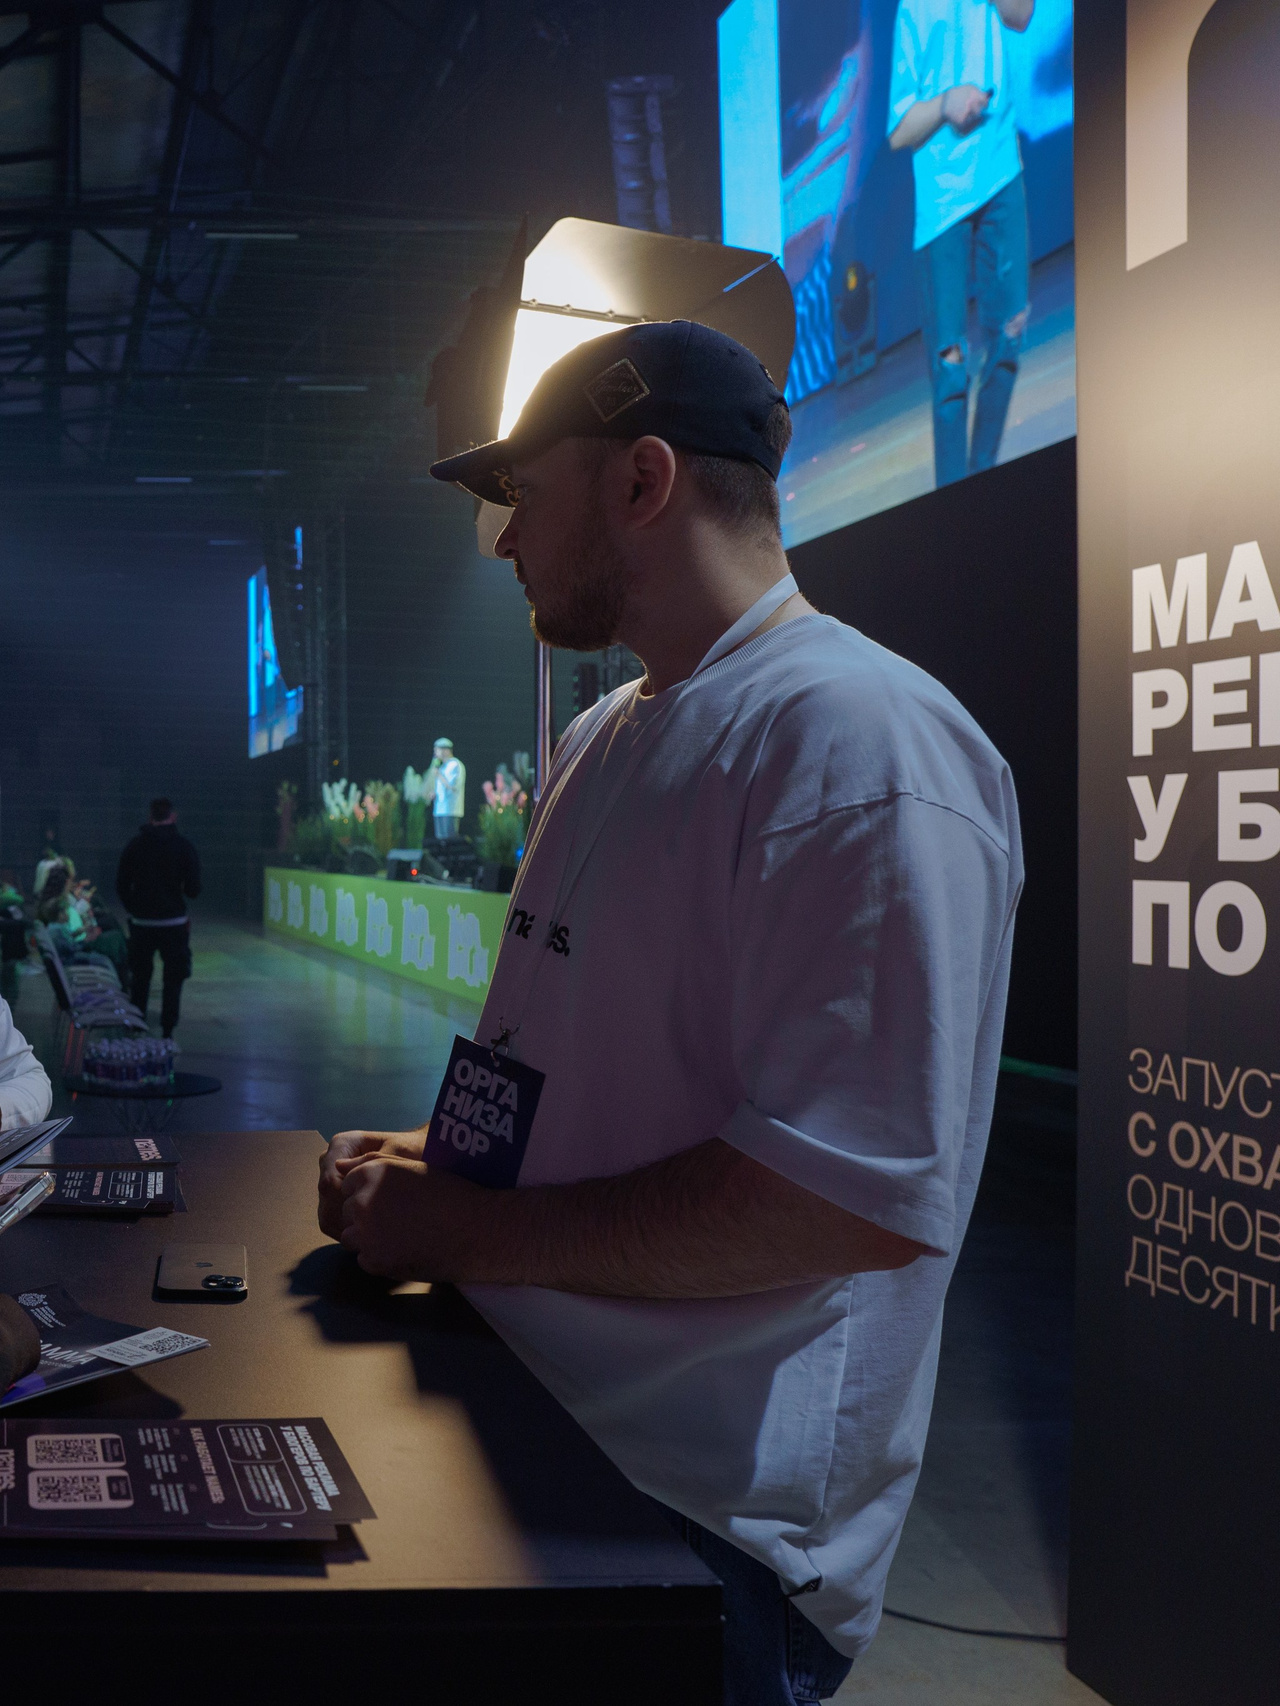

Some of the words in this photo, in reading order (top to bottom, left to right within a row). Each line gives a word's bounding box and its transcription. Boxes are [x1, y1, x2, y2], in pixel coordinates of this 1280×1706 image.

[1131, 540, 1280, 653] МА
[1126, 773, 1189, 863] У
[1217, 768, 1280, 863] Б
[1131, 879, 1267, 976] ПО
[453, 1058, 518, 1112] ОРГА
[1128, 1047, 1280, 1119] ЗАПУС
[438, 1112, 490, 1157] ТОР
[442, 1084, 514, 1144] НИЗА
[1127, 1110, 1157, 1158] С
[1127, 1173, 1280, 1263] ОДНОВ
[189, 1427, 206, 1442] КАК
[194, 1441, 217, 1475] РАБОТАЕТ
[281, 1431, 307, 1466] БЛОГЕРОВ
[303, 1477, 333, 1512] БАРТЕРУ
[313, 1461, 341, 1497] РЕКЛАМА
